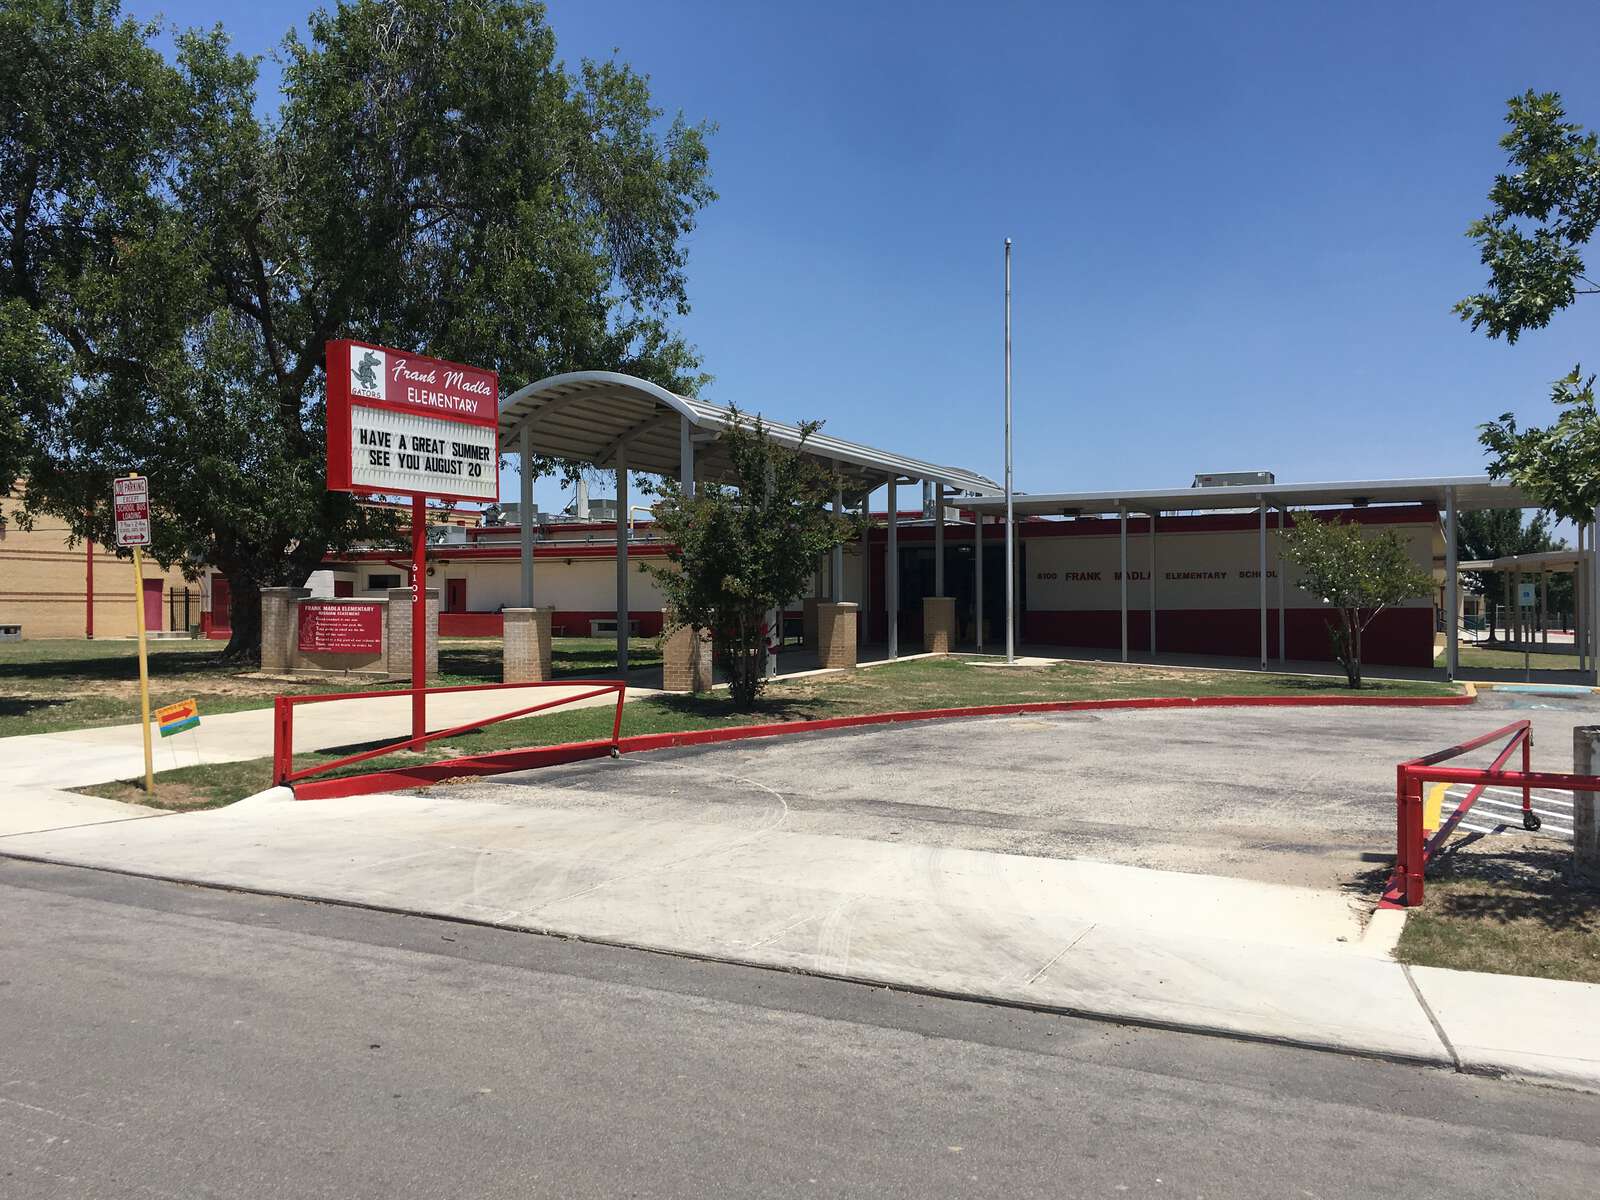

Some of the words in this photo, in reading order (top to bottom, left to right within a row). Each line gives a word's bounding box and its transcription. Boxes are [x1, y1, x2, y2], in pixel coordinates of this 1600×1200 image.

[392, 359, 436, 385] Frank
[443, 371, 492, 396] Madla
[352, 388, 381, 399] GATORS
[407, 387, 478, 413] ELEMENTARY
[360, 429, 391, 448] HAVE
[399, 435, 407, 450] A
[412, 436, 445, 455] GREAT
[452, 442, 490, 461] SUMMER
[370, 450, 390, 467] SEE
[398, 454, 420, 470] YOU
[425, 456, 463, 475] AUGUST
[469, 462, 482, 477] 20
[124, 481, 145, 493] PARKING
[117, 504, 135, 512] SCHOOL
[136, 503, 146, 511] BUS
[122, 511, 142, 520] LOADING
[1065, 571, 1102, 581] FRANK
[1166, 571, 1227, 580] ELEMENTARY
